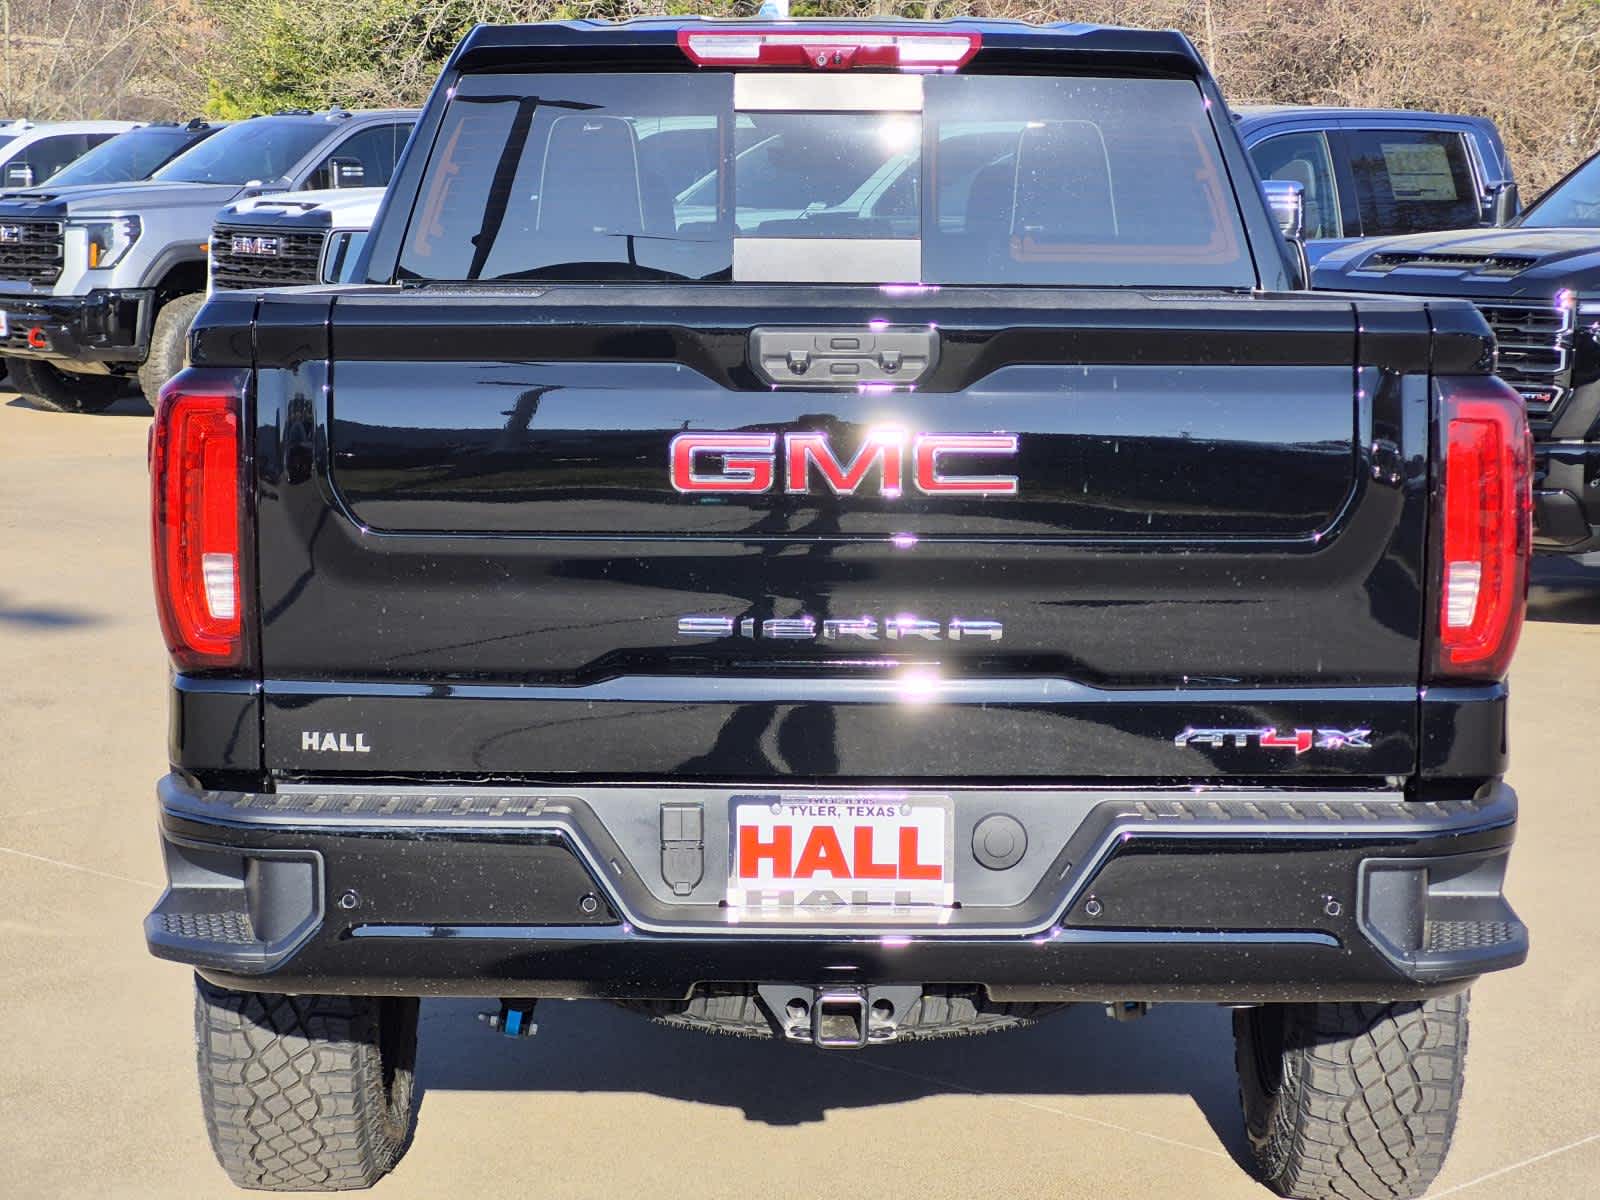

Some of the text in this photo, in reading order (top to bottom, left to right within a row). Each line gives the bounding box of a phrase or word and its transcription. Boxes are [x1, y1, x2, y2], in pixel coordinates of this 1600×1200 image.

[231, 236, 277, 254] GMC
[670, 432, 1020, 497] GMC
[677, 616, 1003, 641] SIERRA
[302, 731, 371, 752] HALL
[1174, 728, 1372, 754] AT4X
[789, 805, 895, 819] TYLER, TEXAS
[739, 825, 942, 880] HALL
